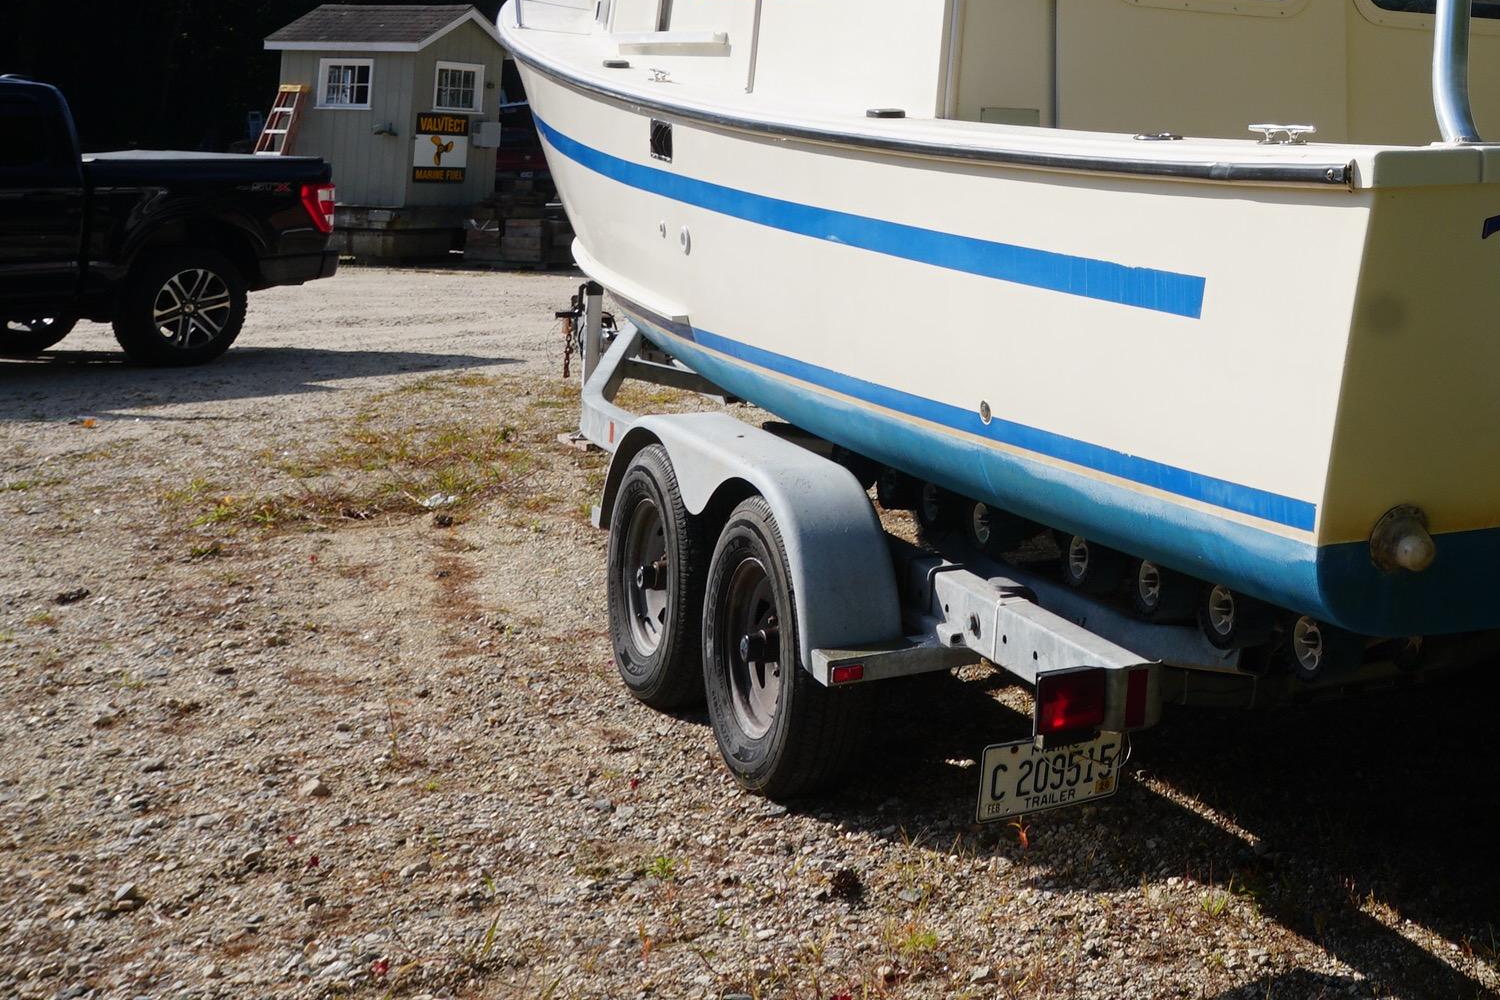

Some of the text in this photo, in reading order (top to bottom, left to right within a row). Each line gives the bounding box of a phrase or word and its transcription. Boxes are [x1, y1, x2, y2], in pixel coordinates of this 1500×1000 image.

[420, 116, 466, 132] VALVTECT
[991, 743, 1116, 801] C 209515
[1024, 788, 1076, 809] TRAILER
